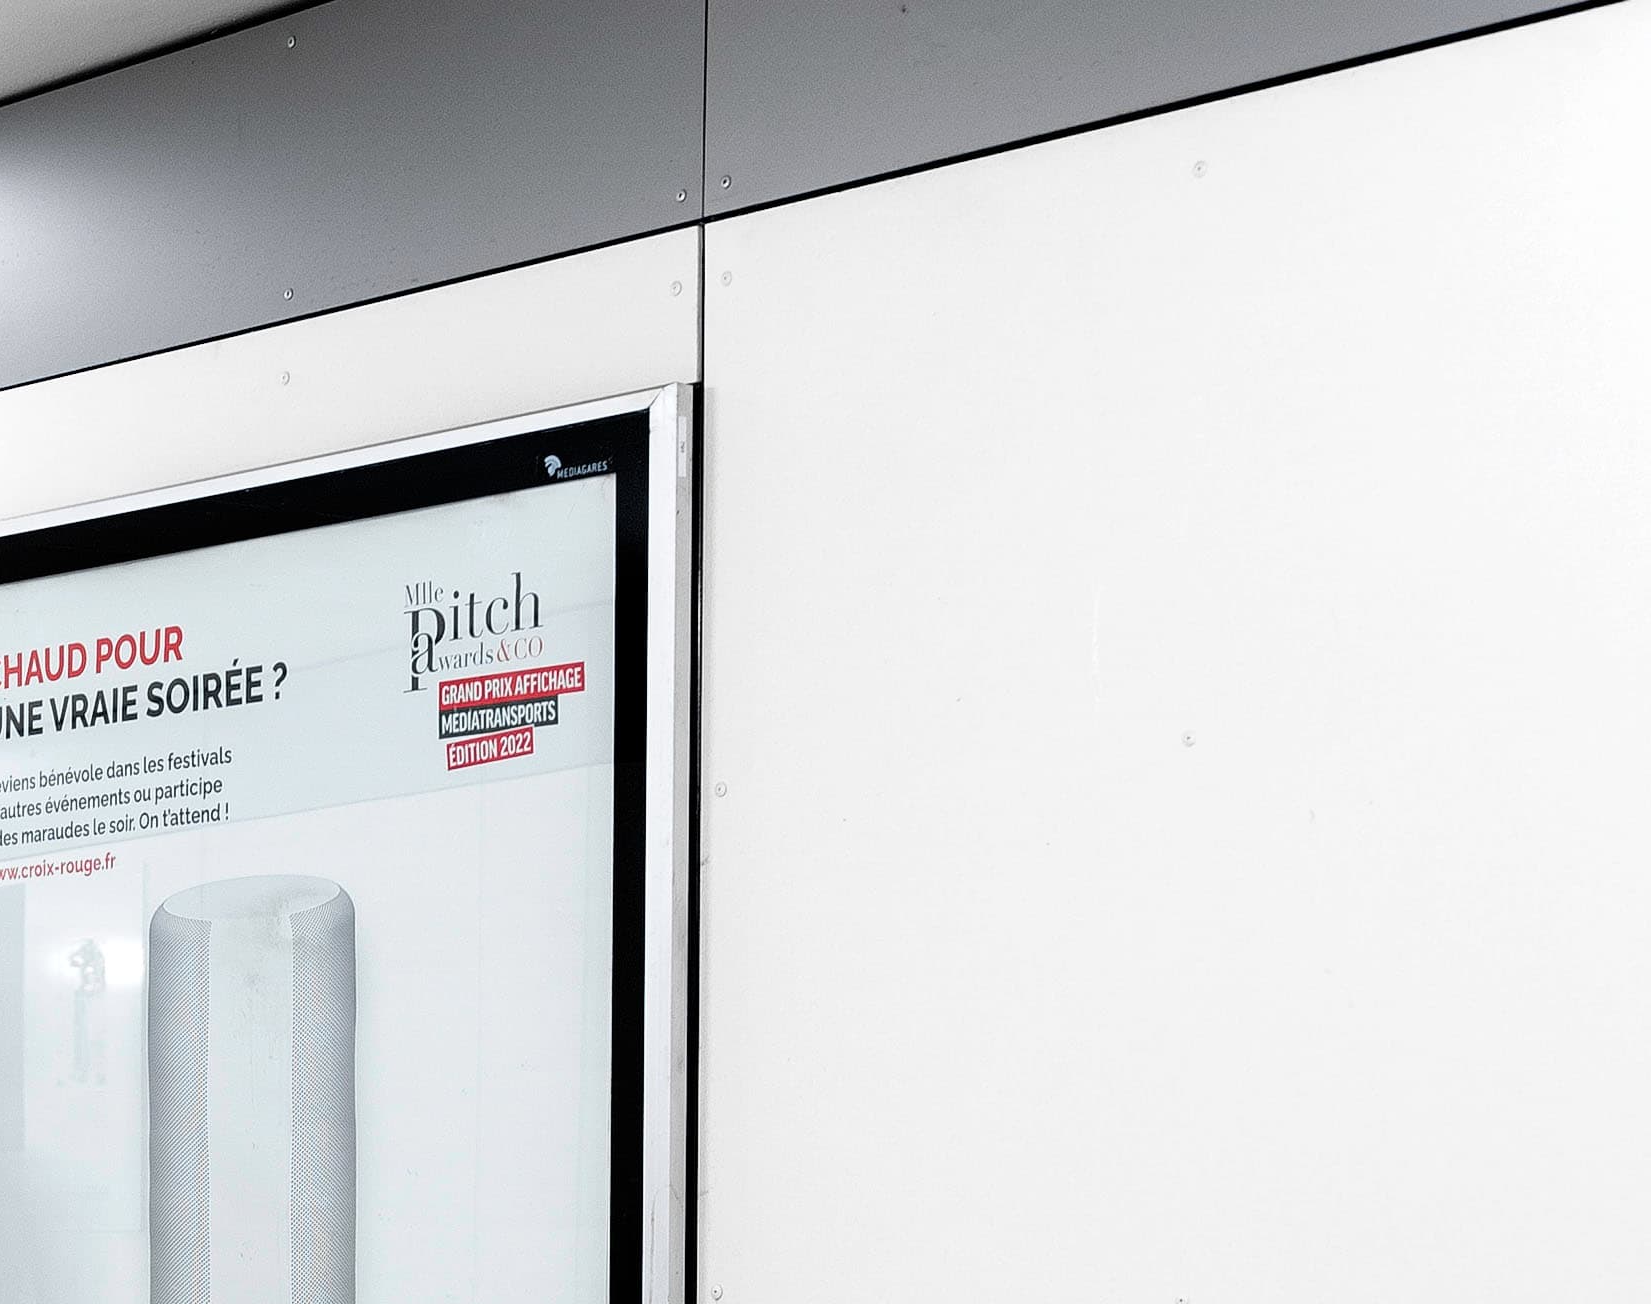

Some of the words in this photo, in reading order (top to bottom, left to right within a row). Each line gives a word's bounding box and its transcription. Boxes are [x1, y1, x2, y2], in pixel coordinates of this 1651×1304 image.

[96, 625, 183, 674] POUR
[50, 685, 138, 732] VRAIE
[146, 658, 263, 718] SOIRÉE
[441, 681, 482, 705] GRAND
[484, 676, 513, 700] PRIX
[514, 667, 582, 695] AFFICHAGE
[39, 764, 103, 788] bénévole
[107, 760, 140, 779] dans
[143, 756, 164, 774] les
[168, 746, 232, 770] festivals
[448, 736, 498, 768] ÉDITION
[500, 732, 532, 757] 2022
[0, 801, 42, 819] autres
[45, 788, 131, 814] événements
[133, 788, 151, 803] ou
[155, 777, 223, 805] participe
[21, 821, 89, 844] maraudes
[93, 818, 106, 836] le
[109, 814, 136, 834] soir.
[139, 812, 159, 829] On
[162, 803, 221, 827] t'attend
